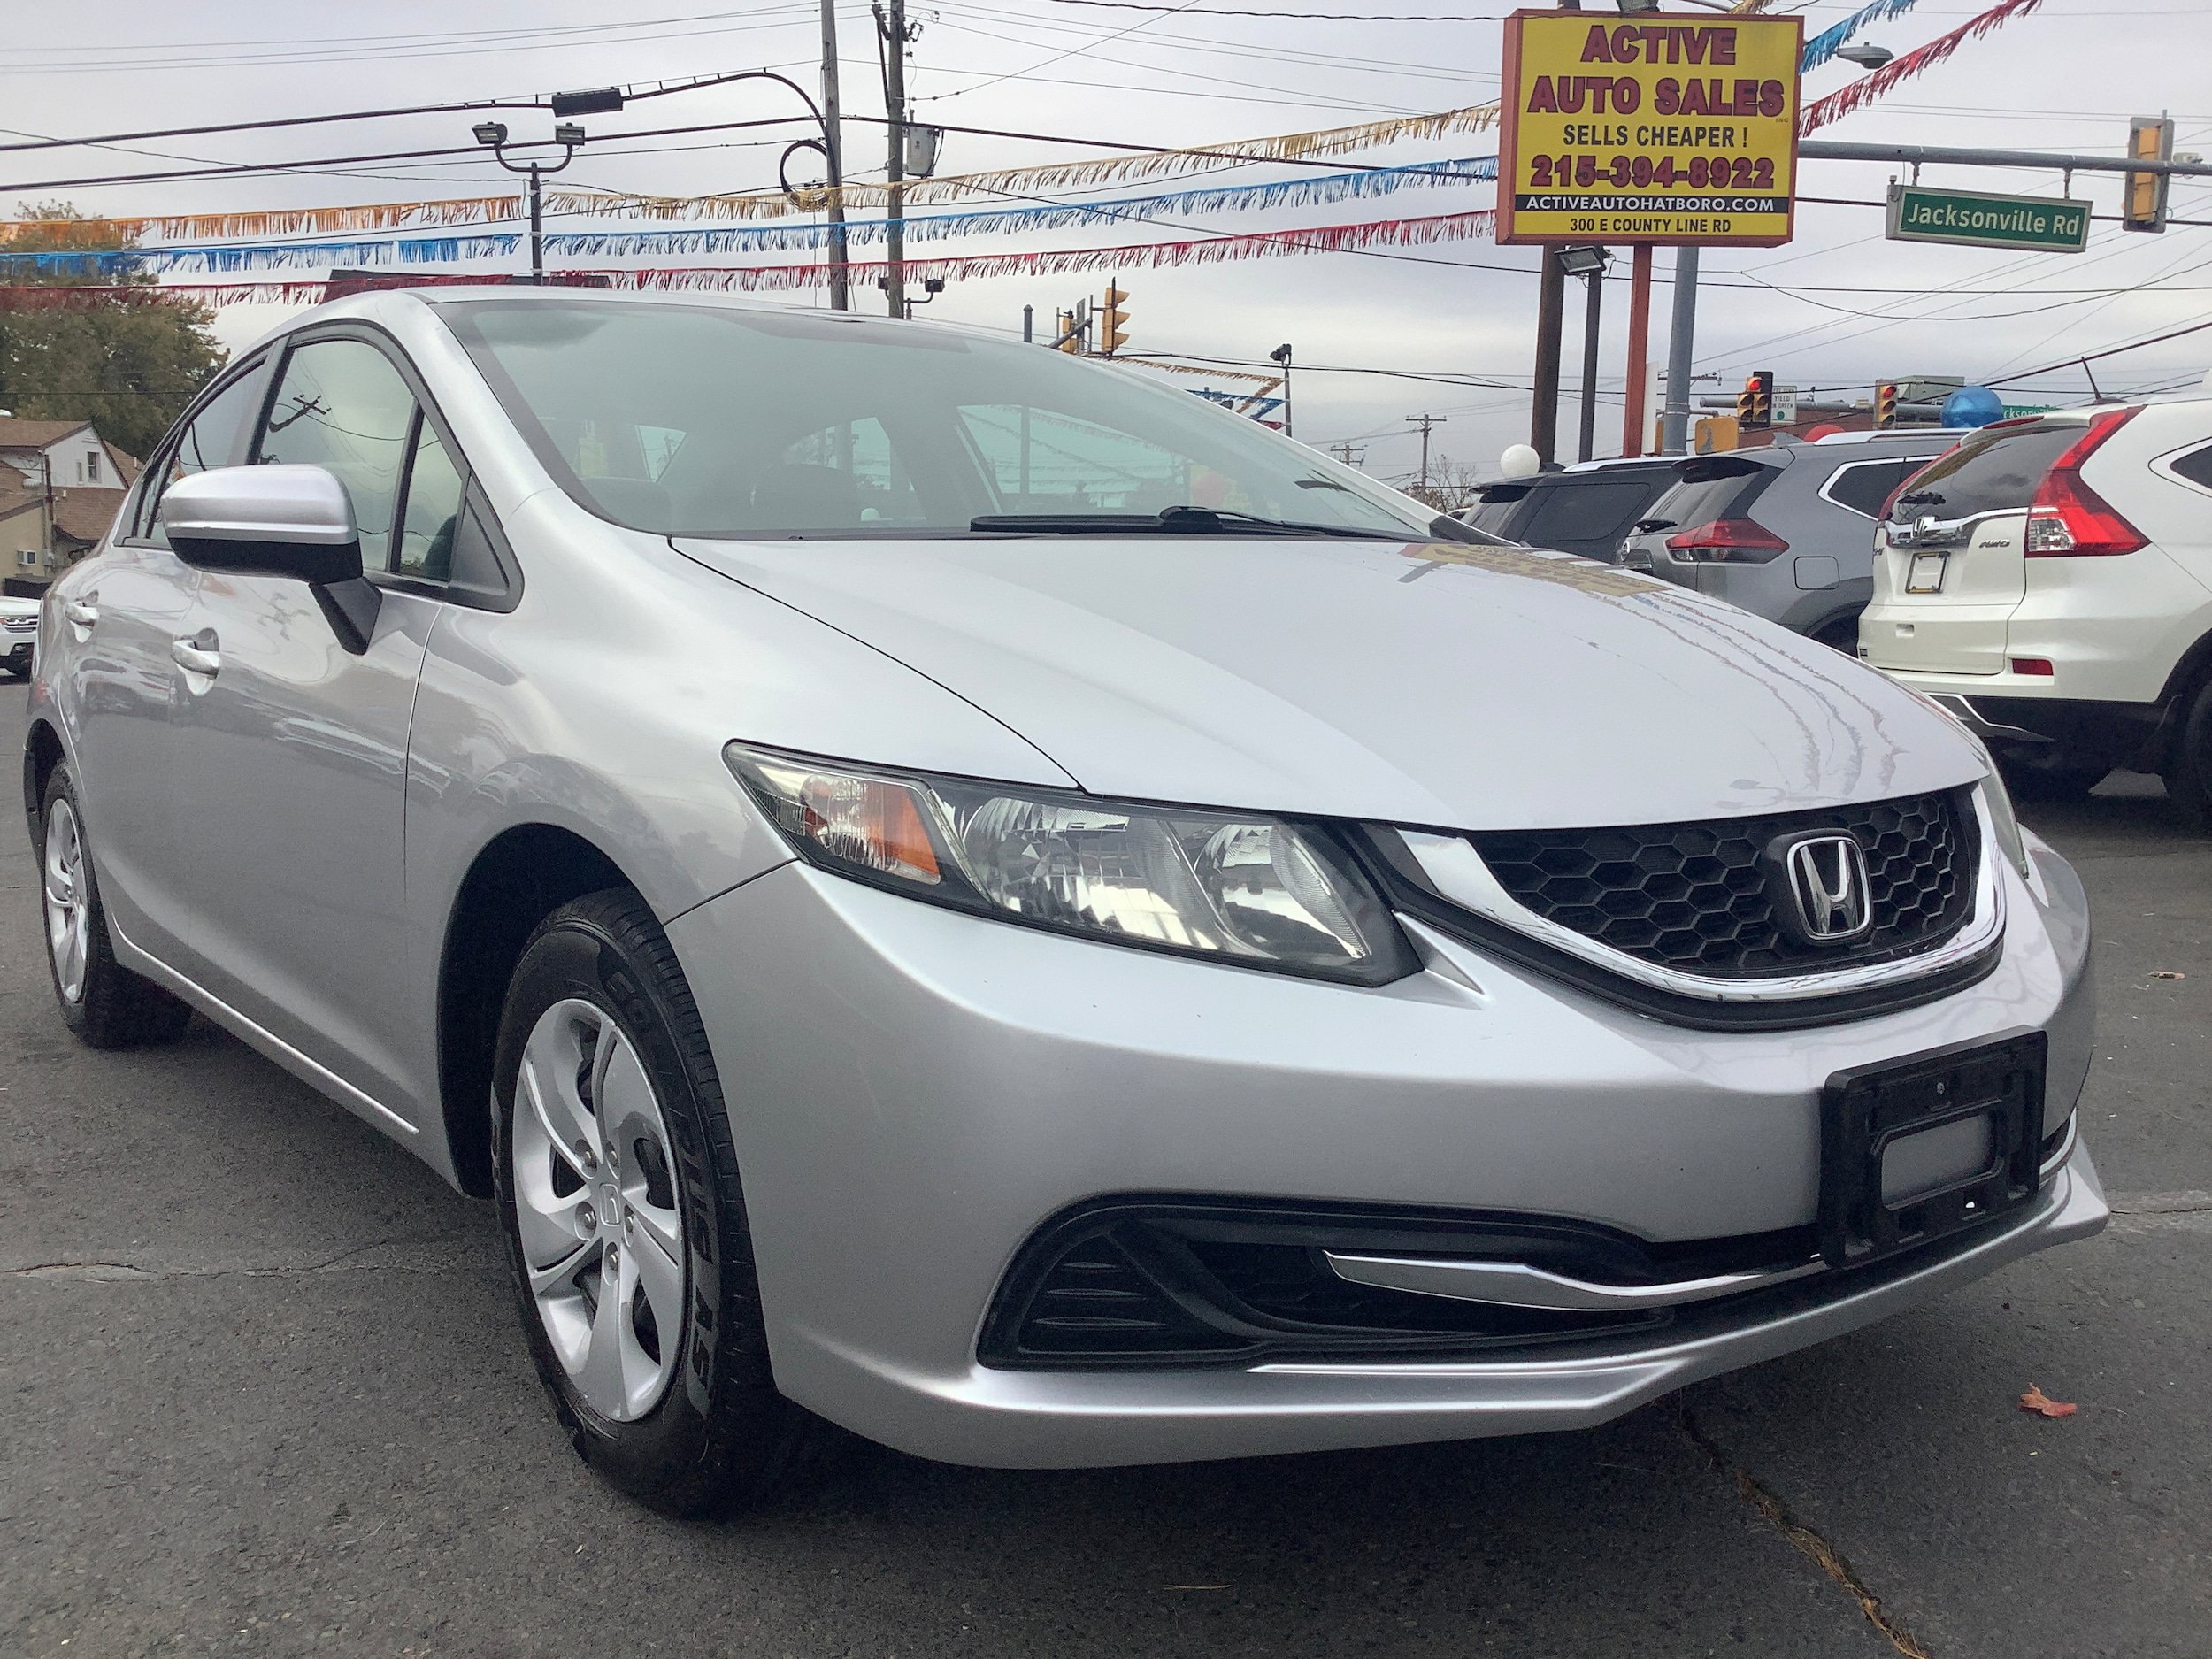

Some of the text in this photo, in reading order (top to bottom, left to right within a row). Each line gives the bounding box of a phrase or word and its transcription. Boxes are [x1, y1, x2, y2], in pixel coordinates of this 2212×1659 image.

[1580, 25, 1737, 65] ACTIVE
[1527, 76, 1784, 117] AUTO SALES
[1563, 124, 1628, 146] SELLS
[1637, 127, 1735, 148] CHEAPER
[1530, 154, 1775, 189] 215-394-8922
[1525, 196, 1774, 211] ACTIVEAUTOHATBORO.COM
[1908, 203, 2078, 236] Jacksonville Rd
[1570, 219, 1732, 233] 300 E COUNTY LINE RD
